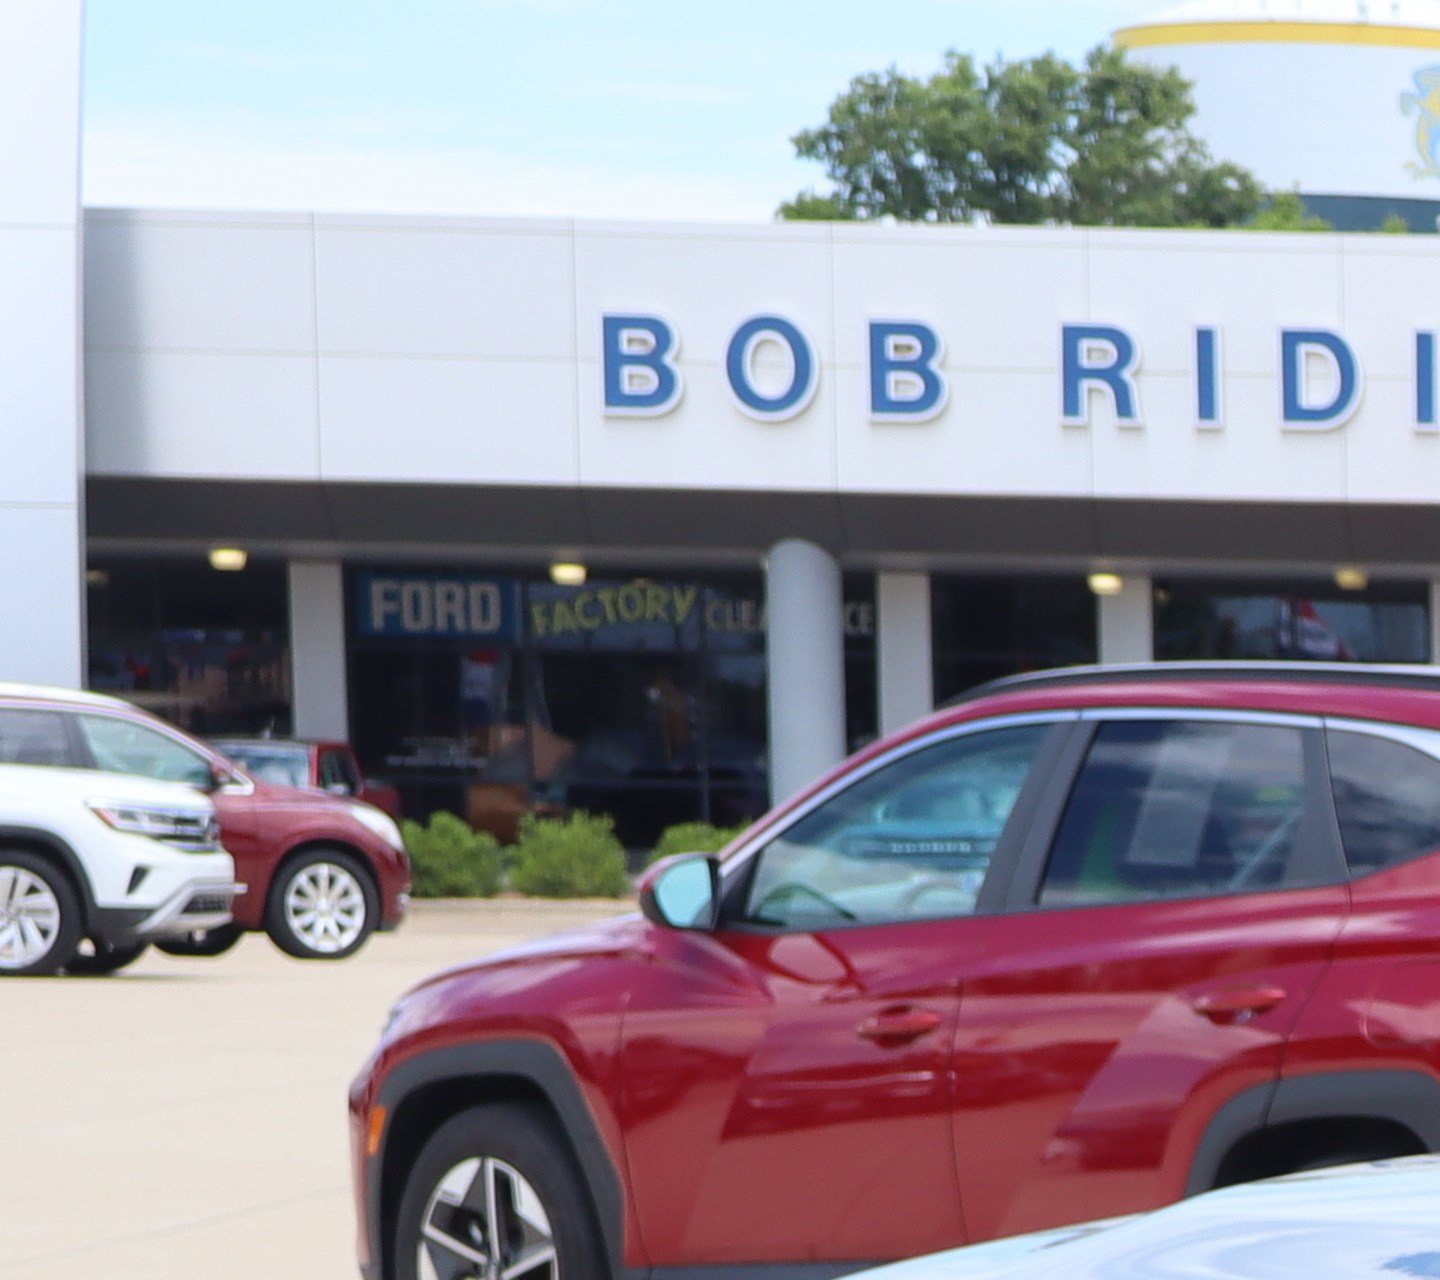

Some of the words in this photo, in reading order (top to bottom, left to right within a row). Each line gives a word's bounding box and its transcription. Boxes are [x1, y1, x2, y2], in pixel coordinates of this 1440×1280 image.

[602, 313, 949, 423] BOB
[370, 579, 502, 635] FORD
[531, 581, 699, 638] FACTORY
